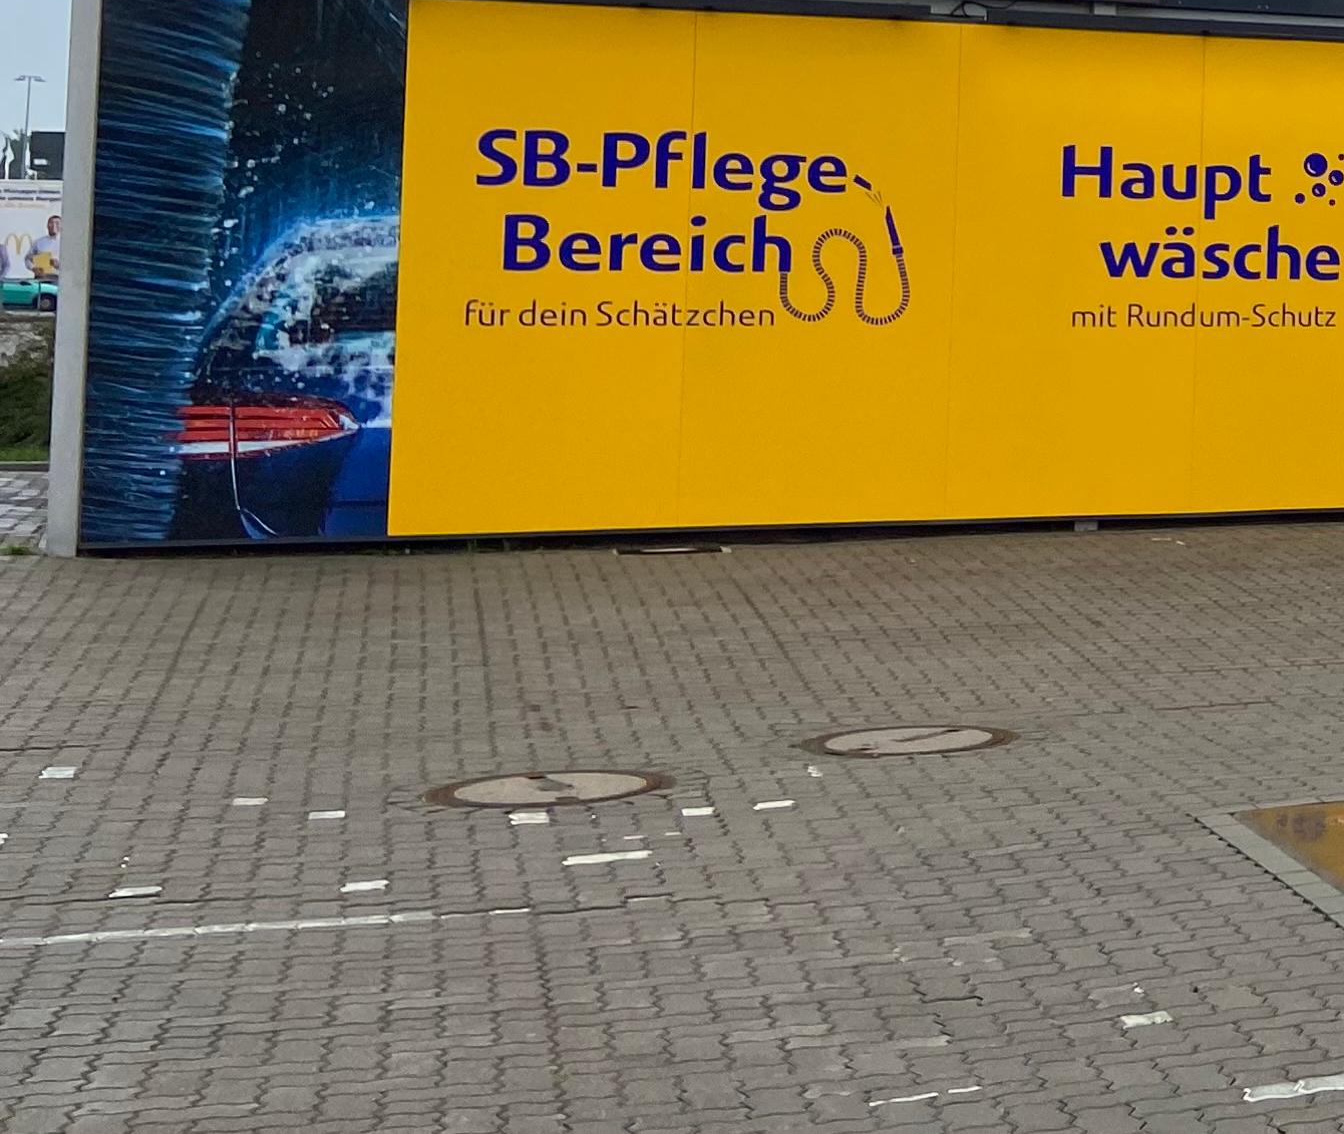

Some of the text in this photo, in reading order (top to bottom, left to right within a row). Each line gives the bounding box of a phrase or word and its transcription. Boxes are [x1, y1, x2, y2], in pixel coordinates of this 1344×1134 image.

[1061, 144, 1272, 220] Haupt
[502, 214, 793, 273] Bereich
[1099, 224, 1341, 281] wäsche
[465, 299, 775, 327] für dein Schätzchen
[1072, 302, 1336, 329] mit Rundum-Schutz
